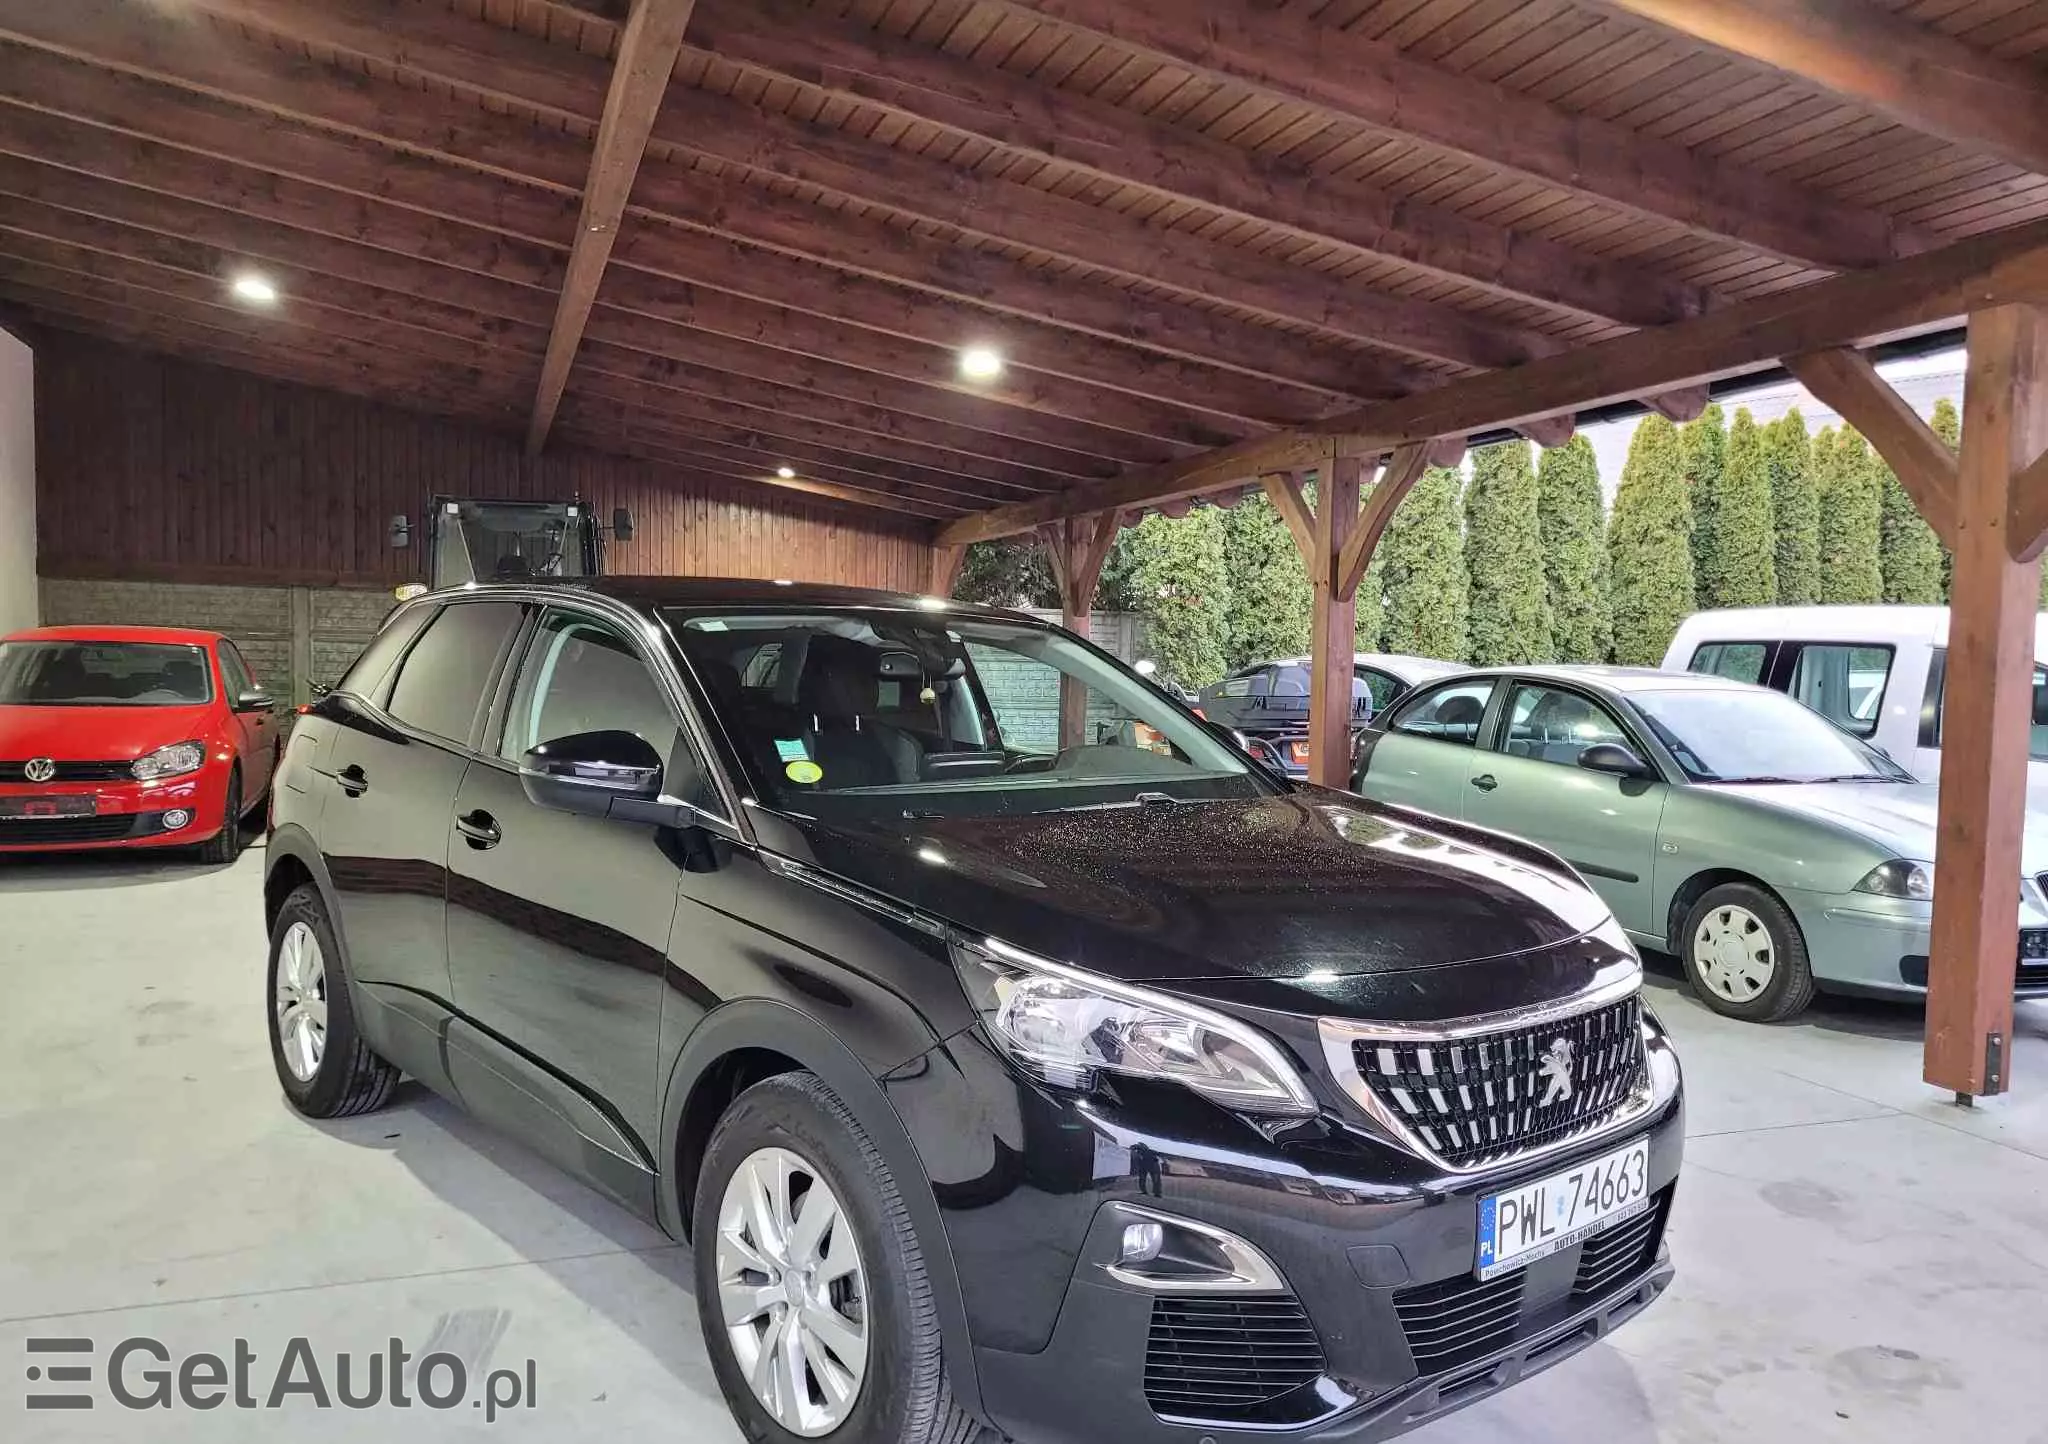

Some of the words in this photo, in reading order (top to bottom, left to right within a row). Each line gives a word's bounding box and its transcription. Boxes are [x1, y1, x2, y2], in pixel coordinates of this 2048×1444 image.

[1498, 1187, 1555, 1255] PWL
[1568, 1149, 1645, 1227] 74663
[1480, 1239, 1493, 1257] PL
[1553, 1219, 1606, 1252] AUTO-HANDEL
